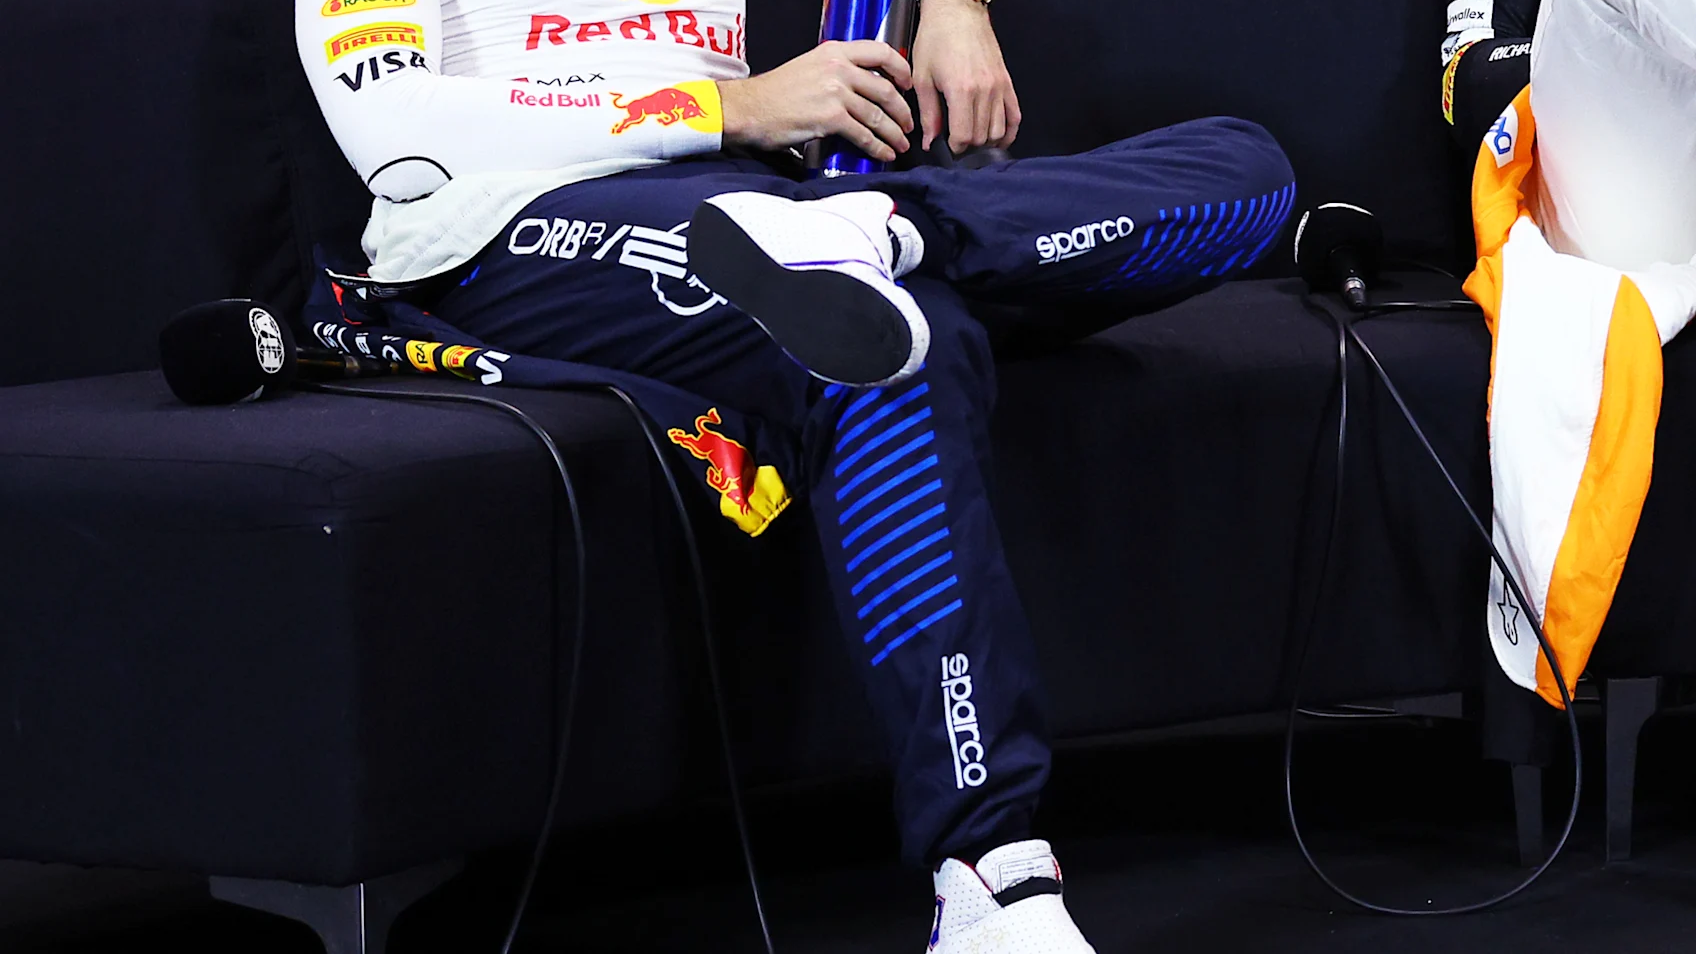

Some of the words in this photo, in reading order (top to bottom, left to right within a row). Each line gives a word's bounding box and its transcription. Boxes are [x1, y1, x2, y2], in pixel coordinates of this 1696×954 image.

[331, 26, 417, 57] PIRELLI
[525, 14, 657, 51] Red
[1489, 43, 1531, 62] RICHA
[333, 51, 431, 93] VISA
[509, 89, 554, 107] Red
[557, 93, 601, 109] Bull
[1036, 216, 1134, 264] sparco
[941, 652, 988, 788] sparco
